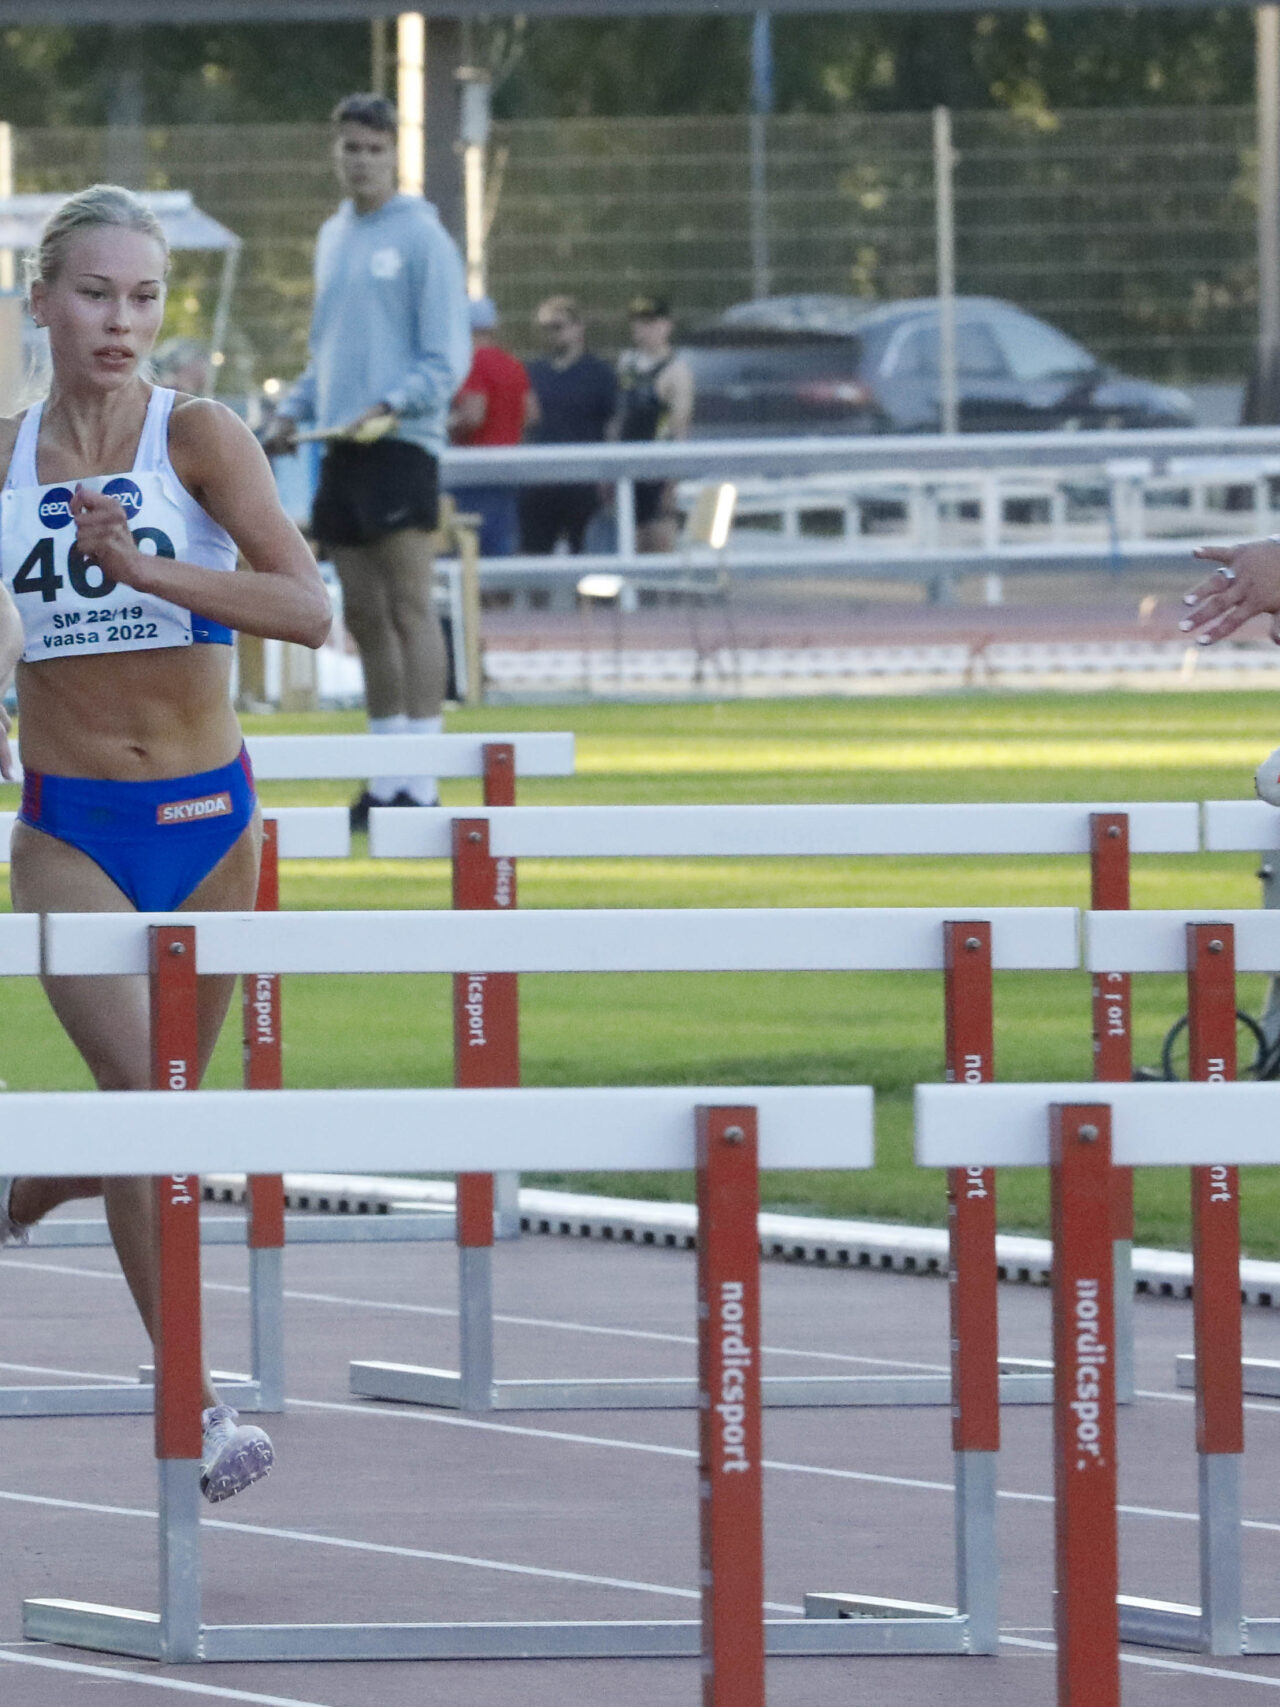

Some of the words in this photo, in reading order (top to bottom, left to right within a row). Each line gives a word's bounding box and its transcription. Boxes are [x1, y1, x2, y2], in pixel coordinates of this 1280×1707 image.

[53, 612, 80, 629] SM
[86, 606, 143, 623] 22/19
[107, 623, 158, 641] 2022
[163, 799, 226, 820] SKYDDA
[464, 975, 487, 1045] icsport
[716, 1281, 751, 1473] nordicsport
